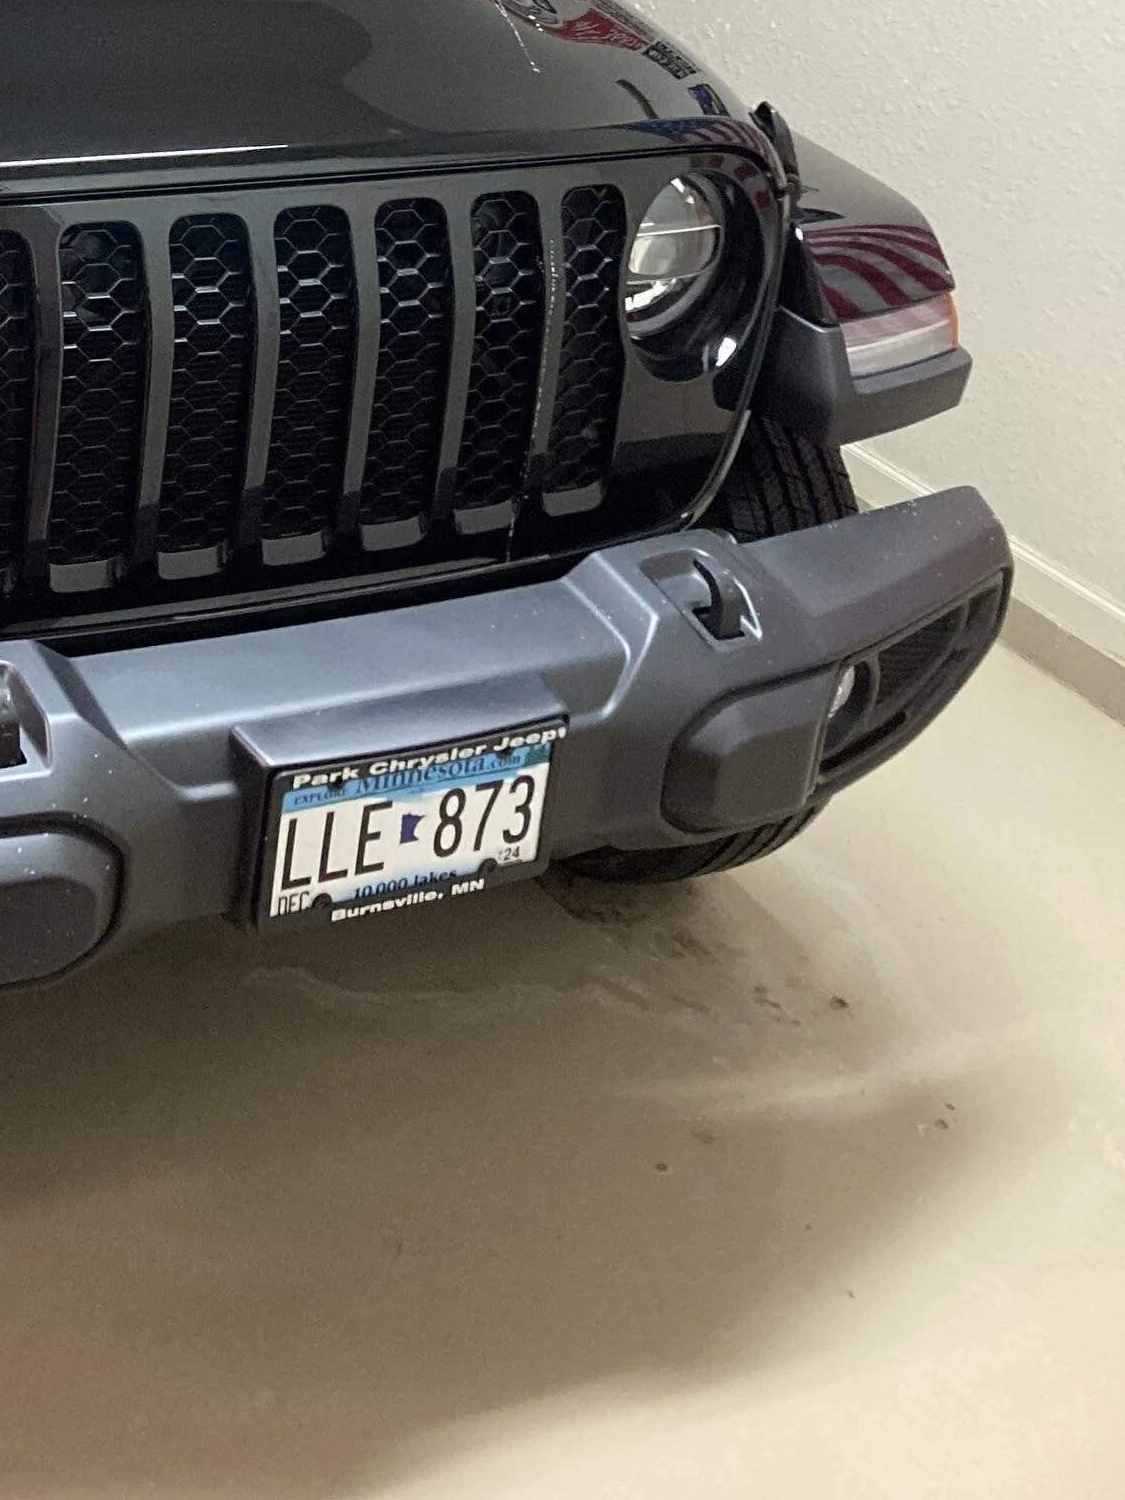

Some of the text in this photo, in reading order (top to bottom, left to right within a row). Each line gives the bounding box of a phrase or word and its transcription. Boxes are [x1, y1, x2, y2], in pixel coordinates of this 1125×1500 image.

[292, 766, 360, 790] Park
[369, 743, 487, 776] Chrysler
[280, 774, 536, 891] LLE 873
[331, 877, 485, 922] Burnsville, MN
[413, 869, 457, 888] lakes
